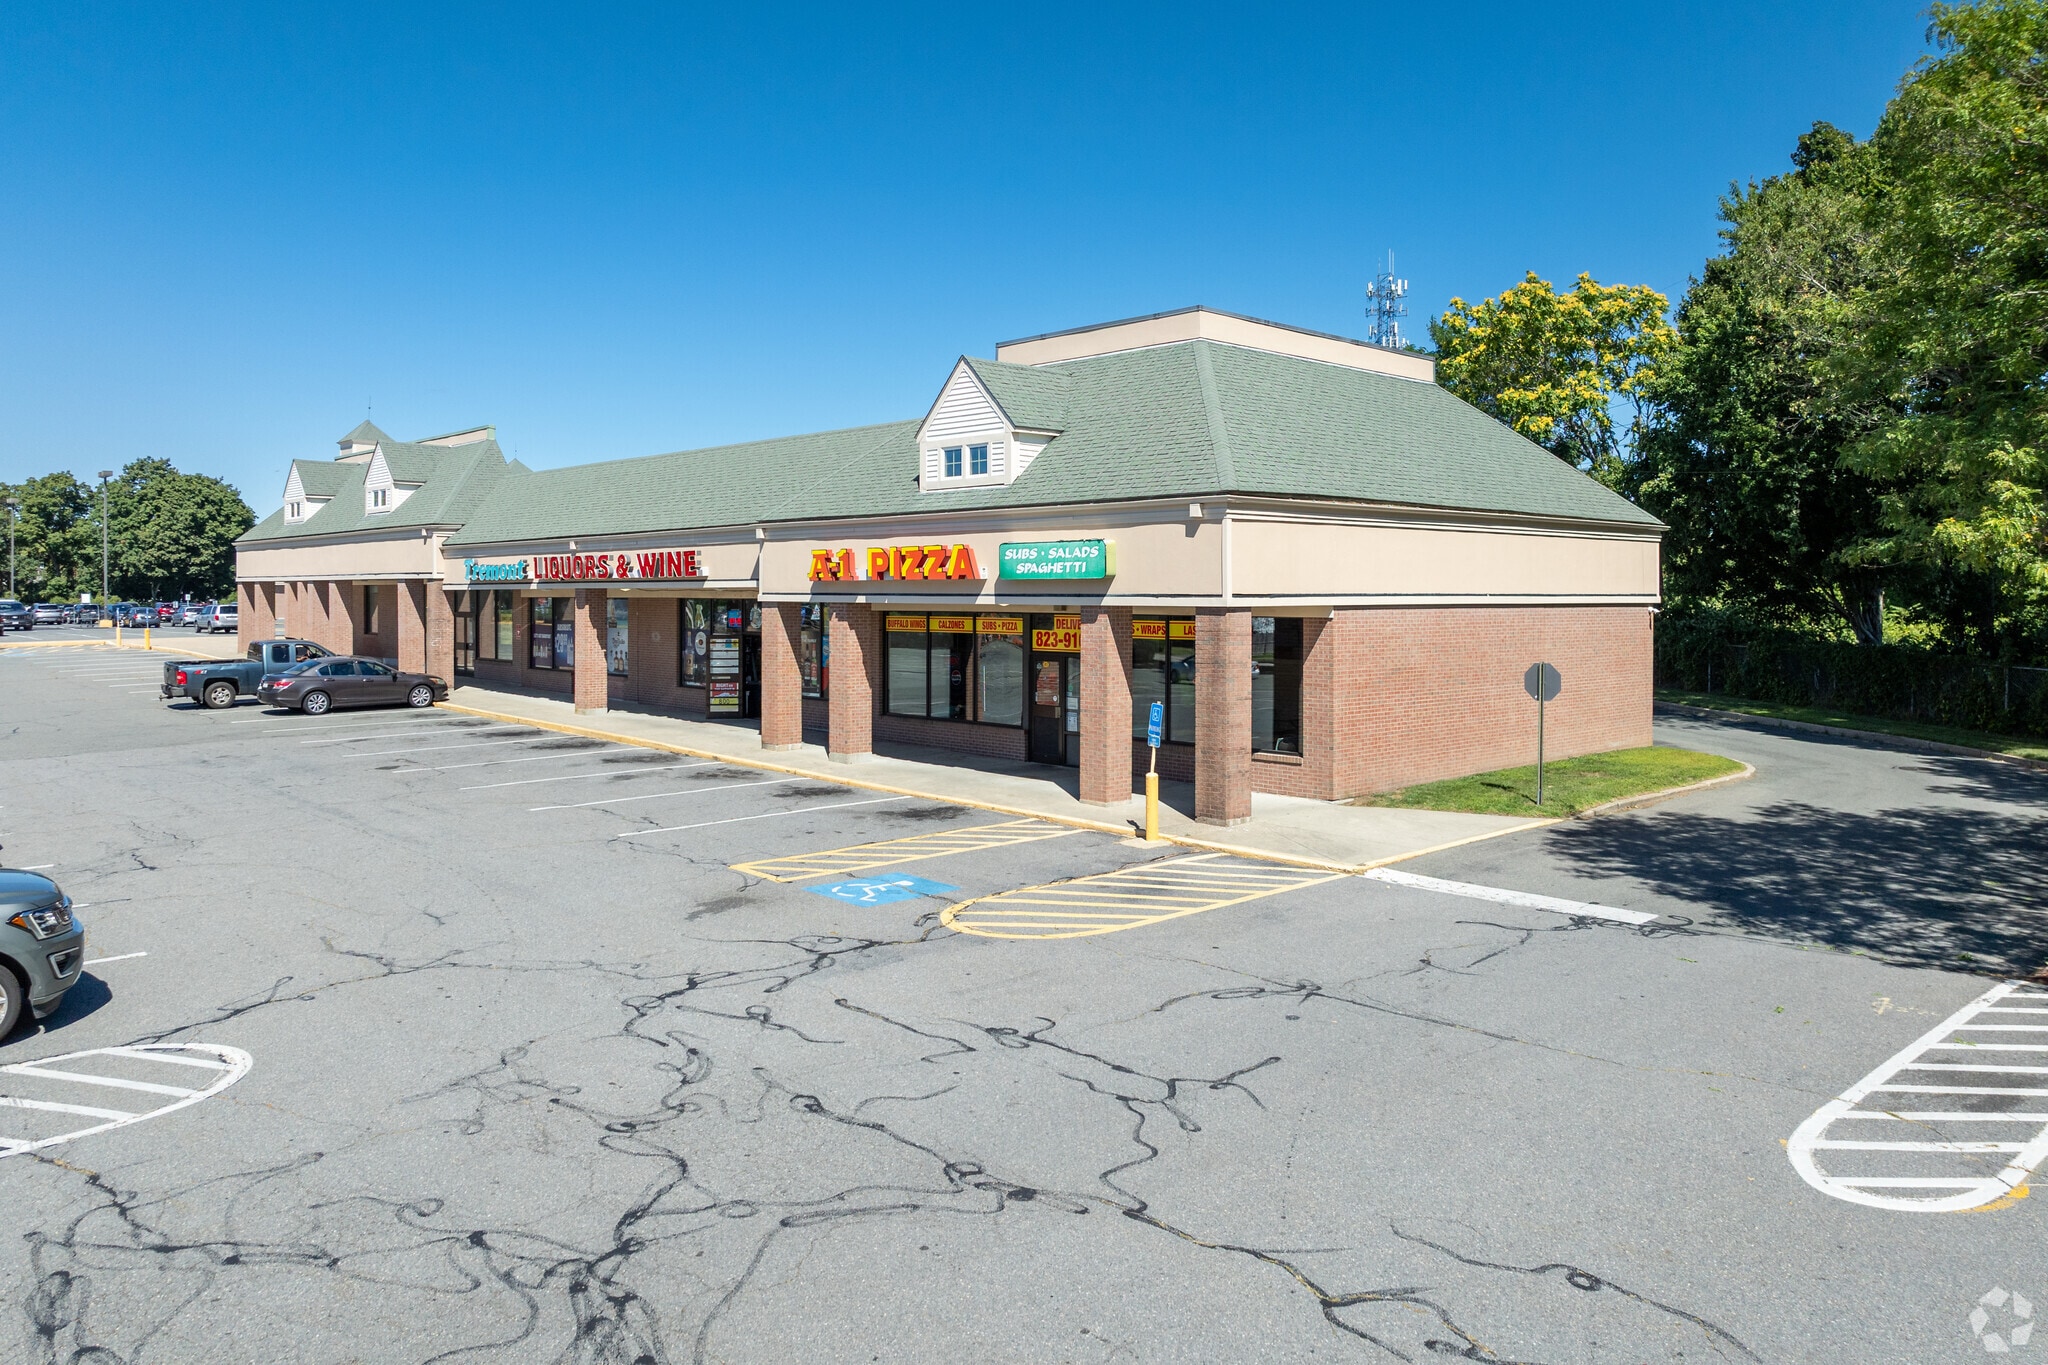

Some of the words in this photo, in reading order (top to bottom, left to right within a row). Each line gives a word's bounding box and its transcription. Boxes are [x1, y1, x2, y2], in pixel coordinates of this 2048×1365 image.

[1004, 548, 1038, 560] SUBS
[1048, 546, 1100, 559] SALADS
[464, 558, 526, 581] Tremont
[533, 555, 609, 581] LIQUORS
[616, 554, 629, 579] &
[636, 550, 698, 579] WINE
[808, 549, 857, 581] A-1
[867, 544, 981, 580] PIZZA
[1016, 561, 1087, 574] SPAGHETTI
[887, 619, 909, 629] BUFFALO
[909, 619, 926, 629] WINGS
[938, 620, 965, 630] CALZONES
[981, 621, 997, 630] SUBS
[1001, 621, 1018, 631] PIZZA
[1140, 624, 1166, 636] WRAPS
